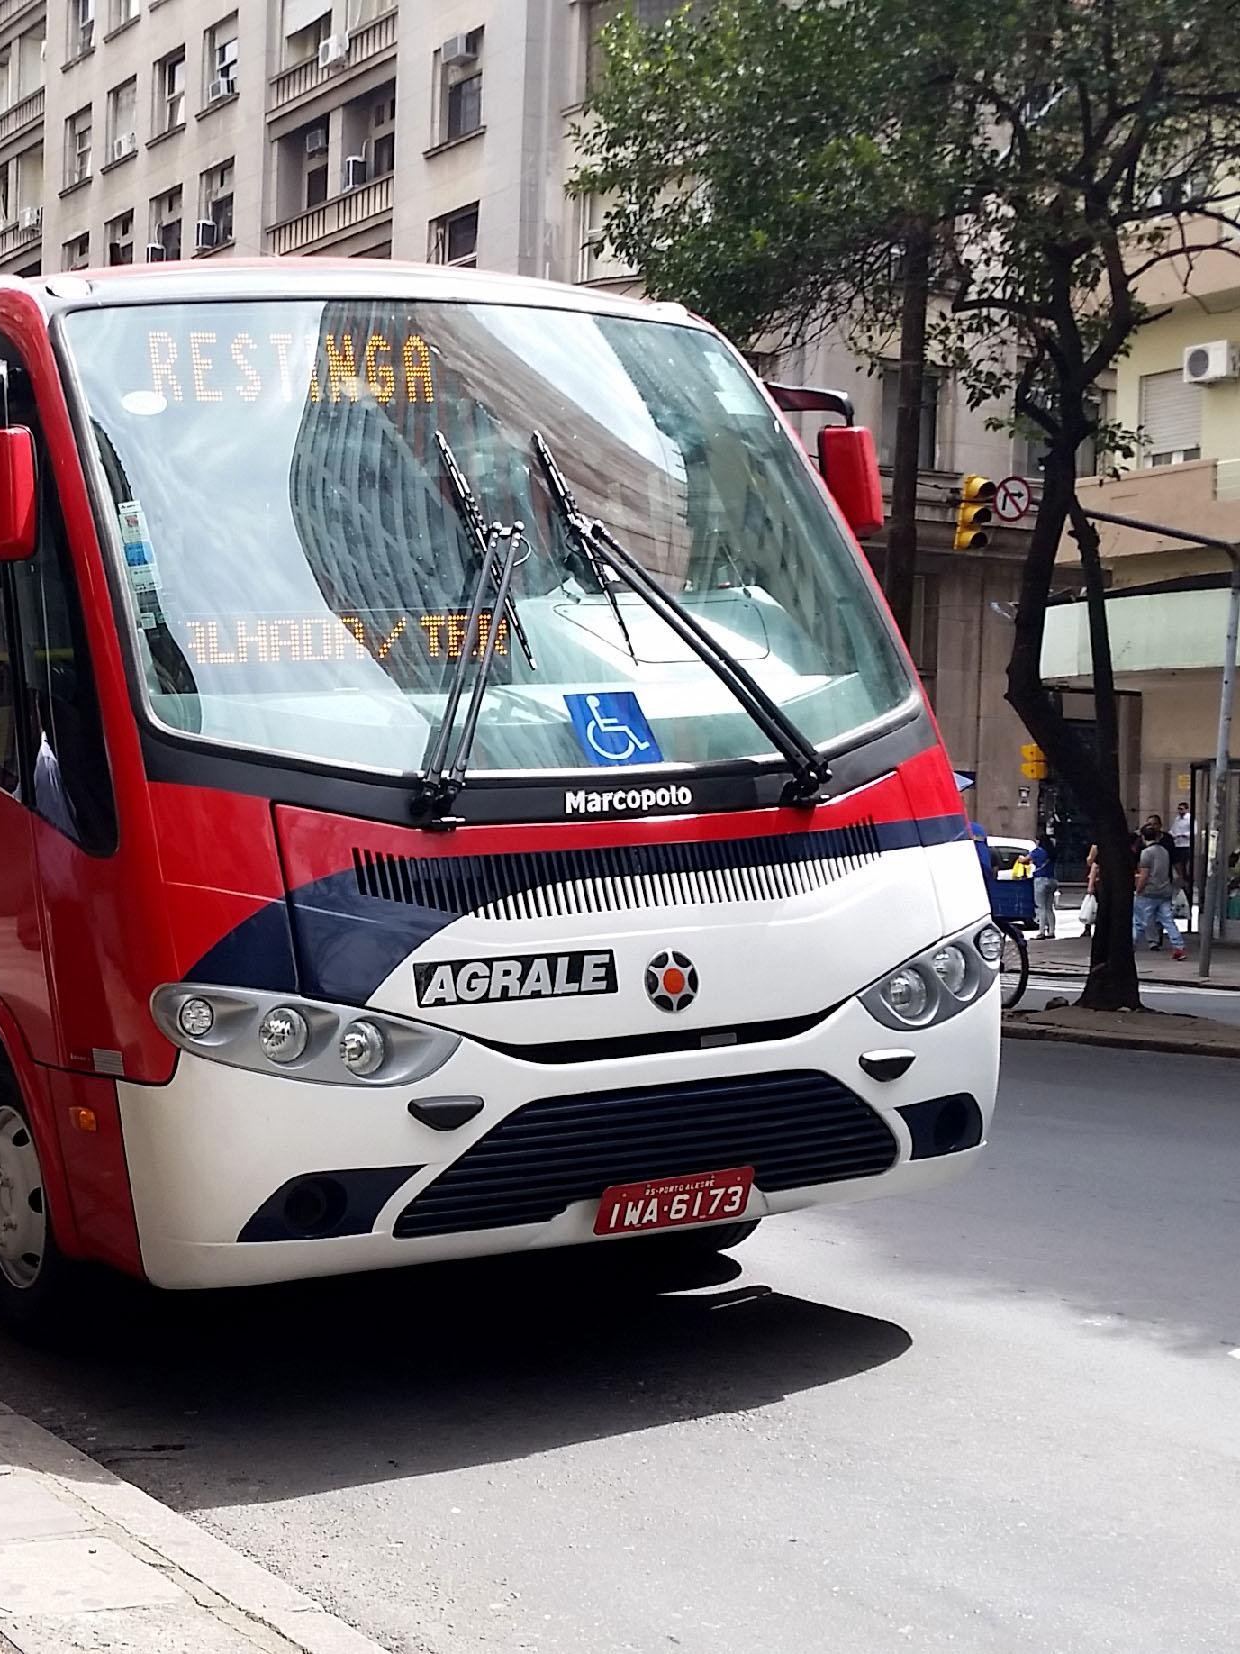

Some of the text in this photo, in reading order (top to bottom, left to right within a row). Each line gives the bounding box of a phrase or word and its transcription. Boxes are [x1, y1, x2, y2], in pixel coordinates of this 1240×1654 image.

[148, 331, 434, 404] RESTINGA
[564, 784, 693, 814] Marcopolo
[420, 953, 611, 1002] AGRALE
